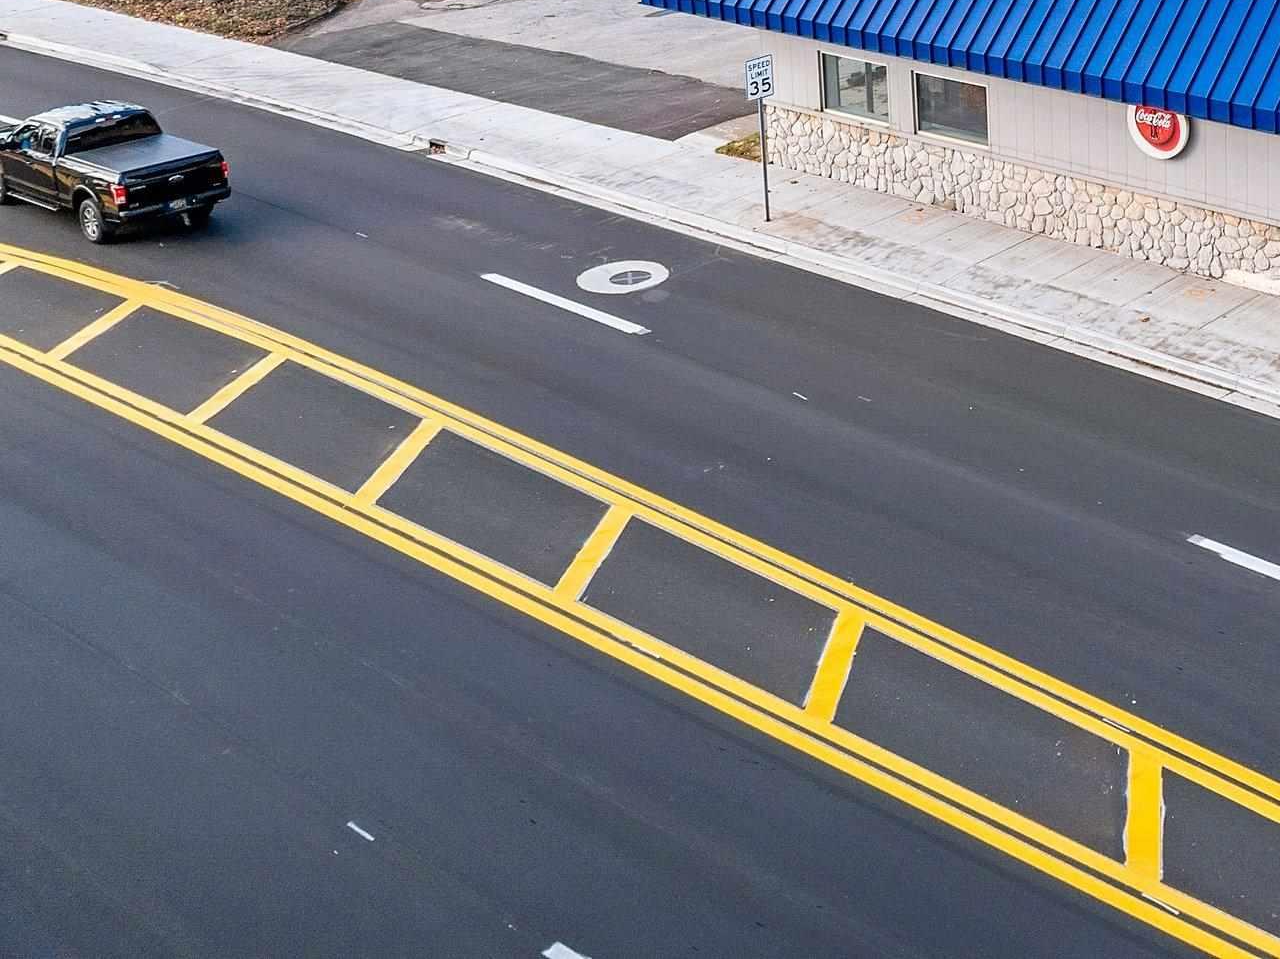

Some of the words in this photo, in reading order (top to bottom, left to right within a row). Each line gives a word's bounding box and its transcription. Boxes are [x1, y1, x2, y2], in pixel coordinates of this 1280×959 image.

[748, 60, 770, 71] SPEED
[750, 68, 768, 79] LIMIT
[750, 76, 771, 96] 35
